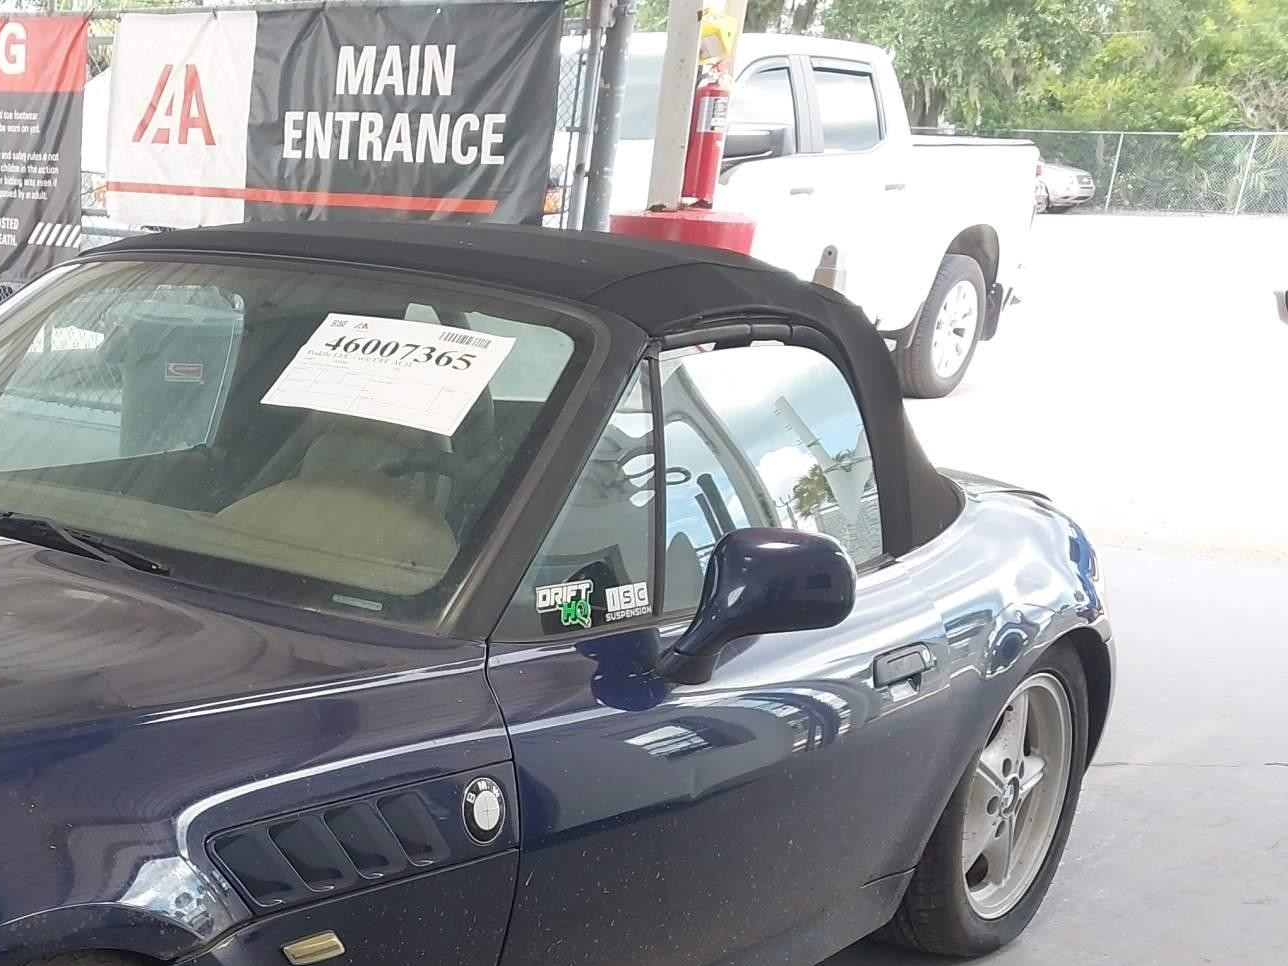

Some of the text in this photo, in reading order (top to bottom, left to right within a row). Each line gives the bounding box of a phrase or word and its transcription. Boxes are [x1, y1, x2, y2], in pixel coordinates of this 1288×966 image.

[335, 44, 456, 96] MAIN
[282, 111, 506, 164] ENTRANCE
[325, 335, 477, 371] 46007365
[537, 582, 591, 608] DRIFT
[605, 582, 649, 612] ISC
[562, 600, 590, 623] HQ
[605, 606, 652, 622] SUSPENSION
